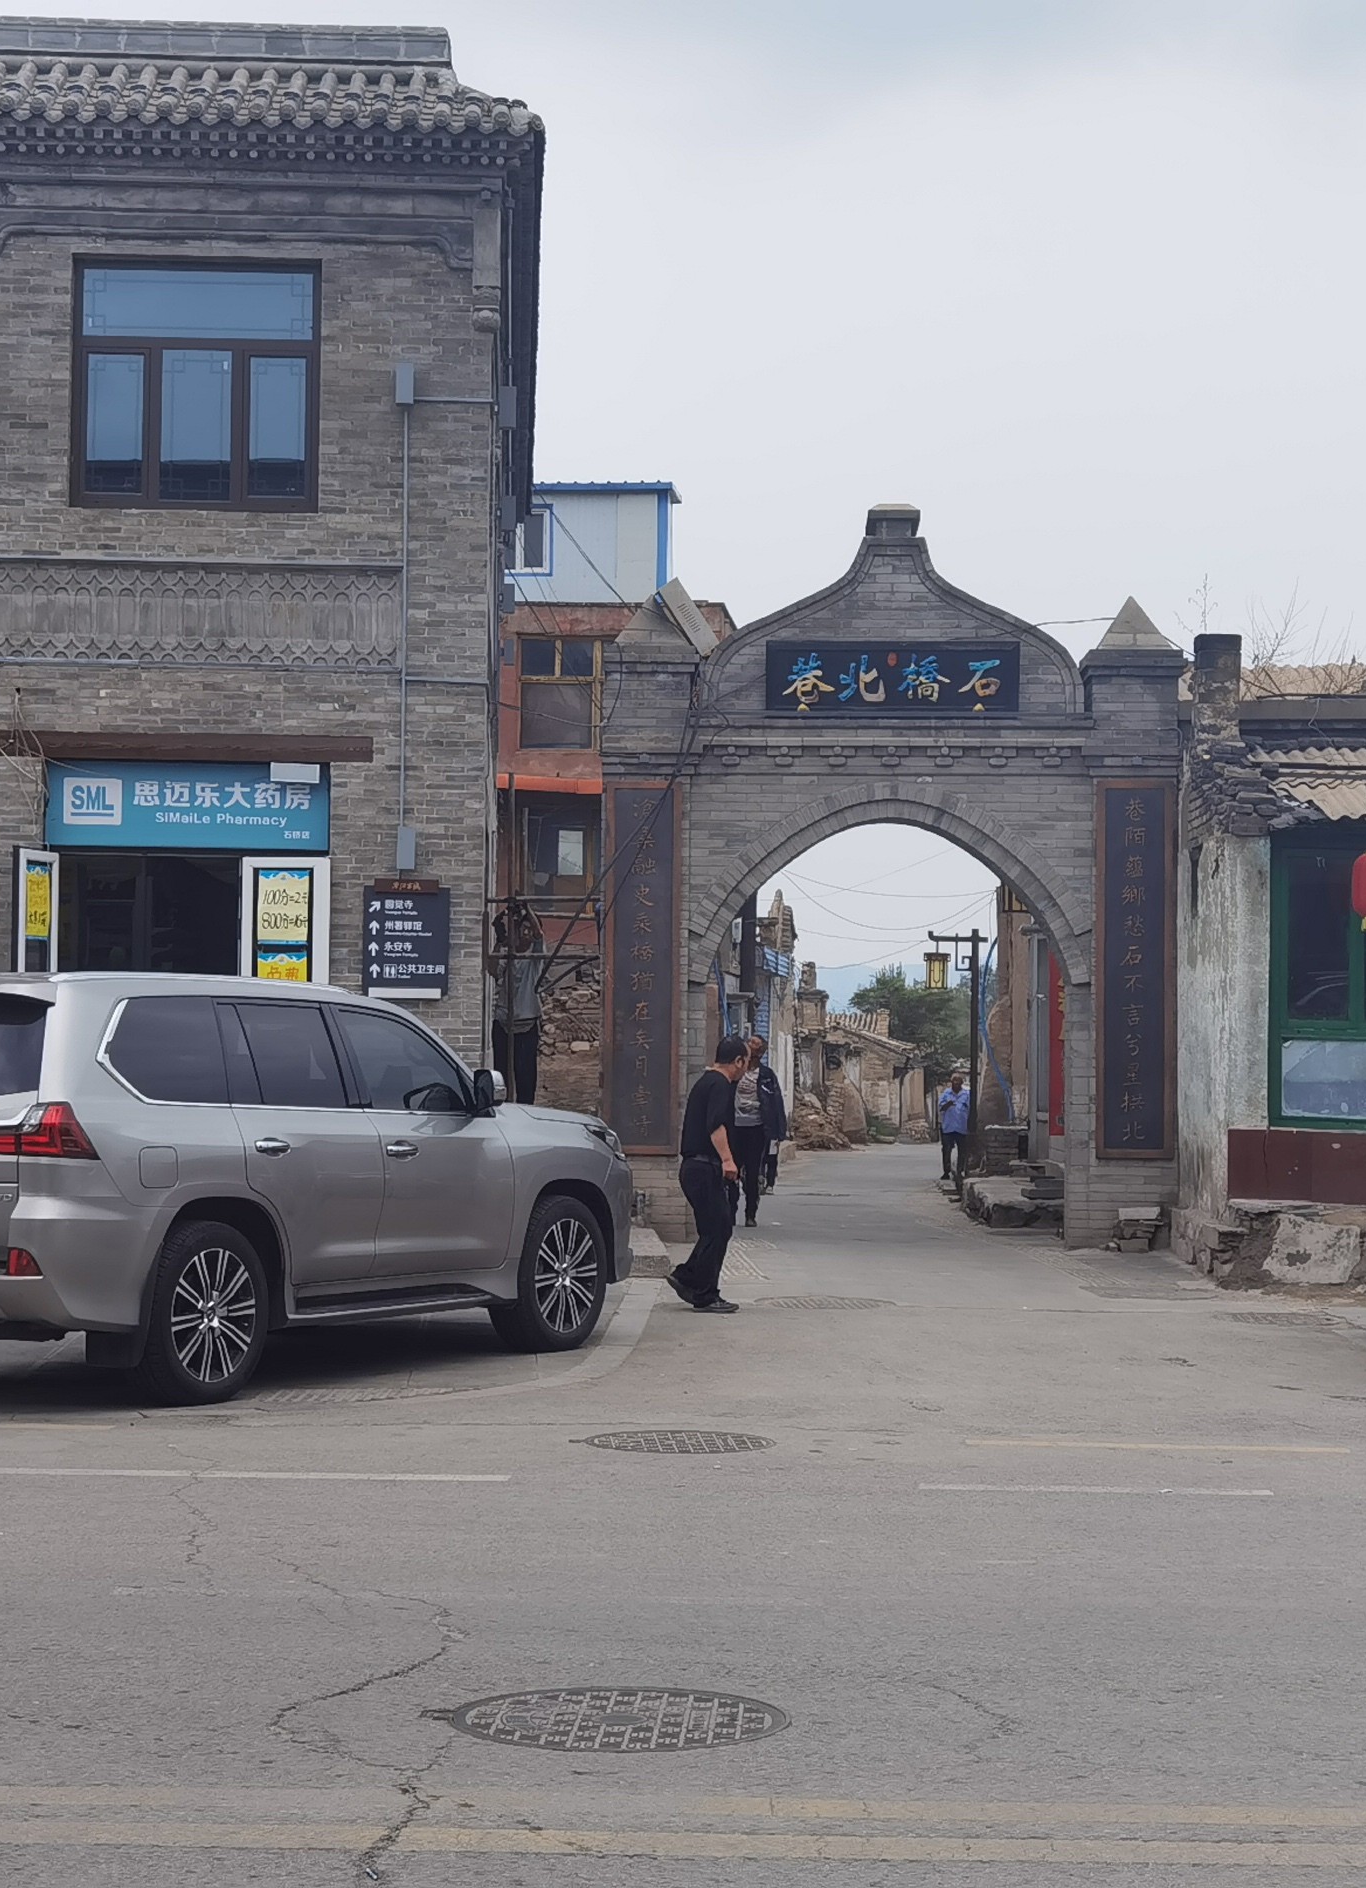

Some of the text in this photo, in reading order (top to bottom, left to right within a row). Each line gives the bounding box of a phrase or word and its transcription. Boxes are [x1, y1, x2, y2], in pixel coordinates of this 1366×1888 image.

[71, 785, 115, 811] SML
[132, 780, 312, 810] 思迈乐大药房
[216, 813, 288, 828] Pharmacy
[383, 941, 412, 952] 永安寺
[398, 963, 446, 975] 公共卫生间
